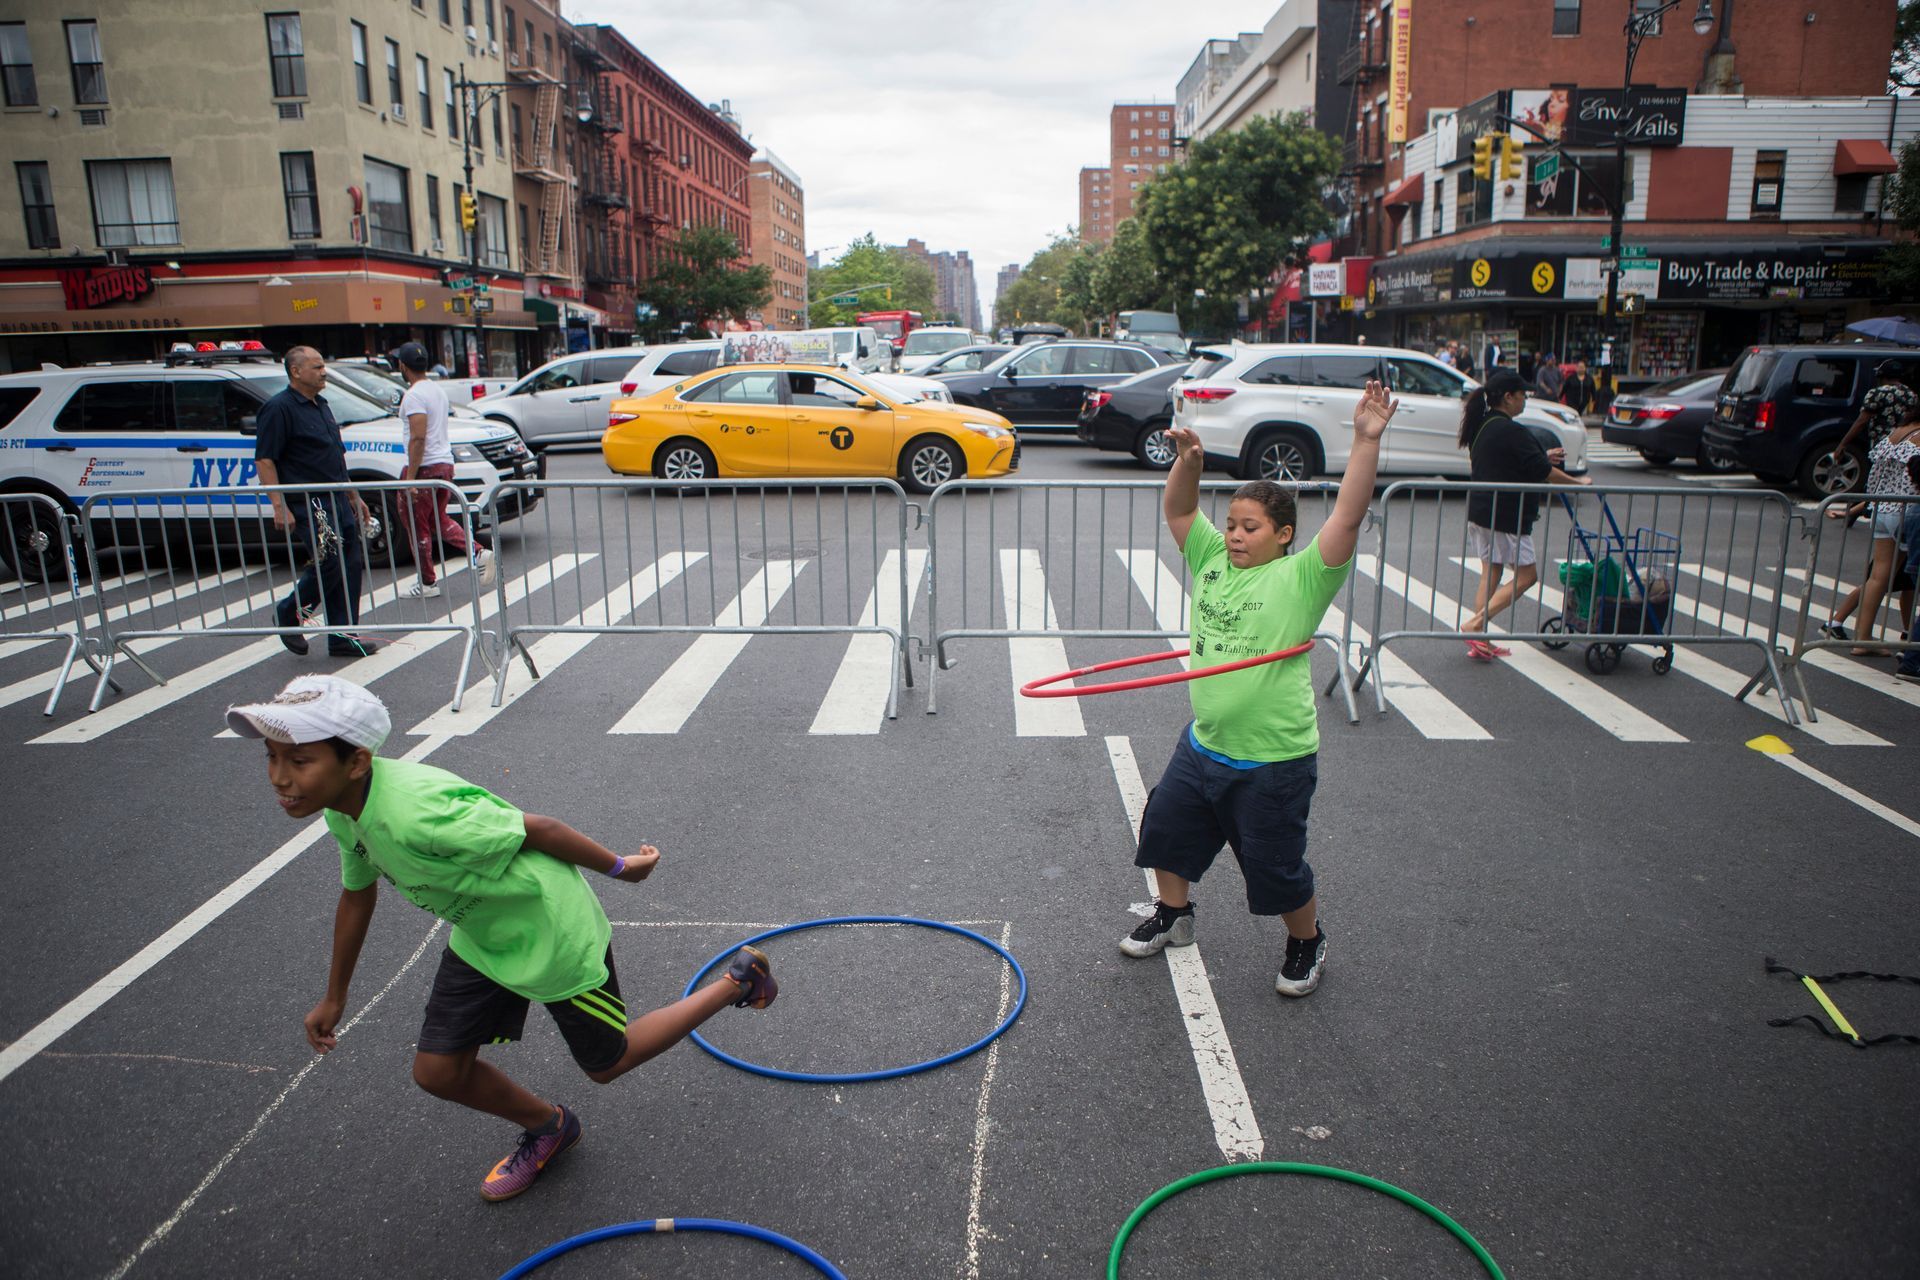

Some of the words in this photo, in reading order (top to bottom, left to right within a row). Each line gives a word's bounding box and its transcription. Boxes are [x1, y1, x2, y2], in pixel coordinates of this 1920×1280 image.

[1398, 24, 1408, 64] BEAUTY
[1395, 71, 1406, 111] SUPPLY
[1625, 113, 1678, 136] Nails
[1313, 269, 1337, 281] HARVARD
[1755, 261, 1769, 279] &
[1773, 261, 1828, 287] Repair
[1313, 280, 1338, 292] FARMACIA
[1411, 269, 1432, 292] Repair
[1569, 280, 1603, 289] Perfumes
[1620, 281, 1654, 291] Colognes
[72, 318, 181, 330] HAMBURGERS
[10, 439, 24, 449] PCT
[351, 442, 393, 452] POLICE
[190, 458, 266, 488] NYP
[1242, 602, 1264, 611] 2017
